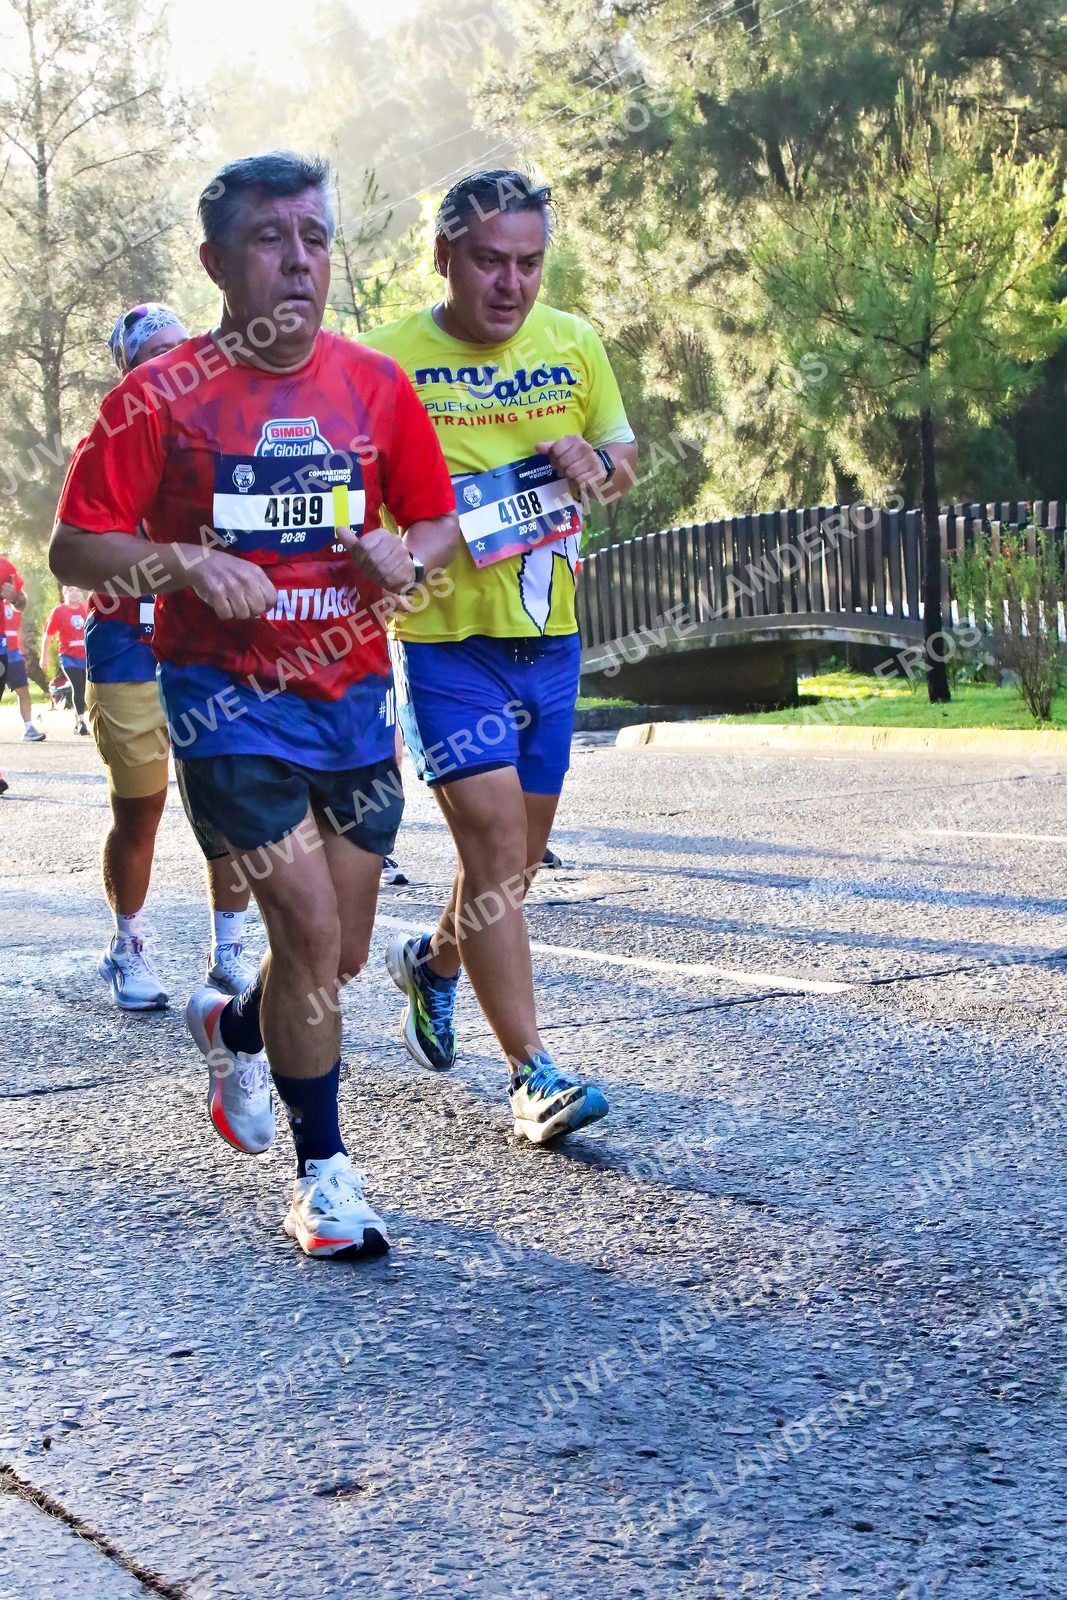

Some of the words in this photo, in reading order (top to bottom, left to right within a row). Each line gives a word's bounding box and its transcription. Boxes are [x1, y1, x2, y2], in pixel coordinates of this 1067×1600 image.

[499, 389, 573, 408] VALLARTA
[432, 413, 518, 426] TRAINING
[526, 405, 567, 420] TEAM
[271, 426, 313, 438] BIMBO
[274, 442, 313, 457] Global
[264, 495, 324, 528] 4199
[497, 490, 543, 525] 4198
[556, 521, 573, 534] 10K
[331, 544, 347, 553] 10
[264, 585, 361, 621] NTIAGO
